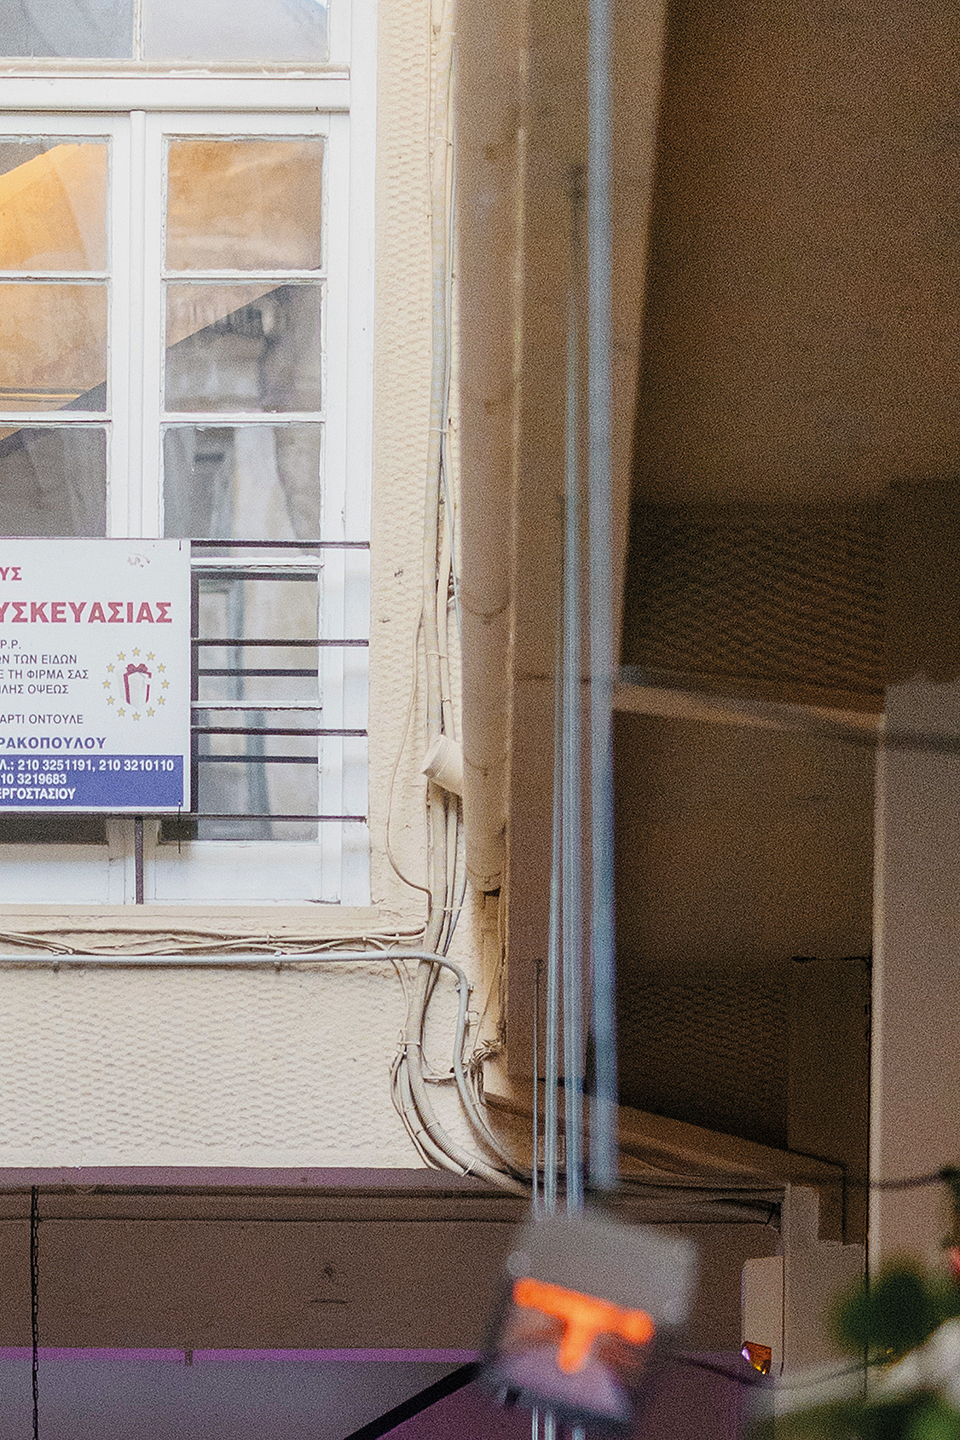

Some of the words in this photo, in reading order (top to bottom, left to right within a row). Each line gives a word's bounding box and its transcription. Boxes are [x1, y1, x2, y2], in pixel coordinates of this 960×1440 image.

[13, 653, 38, 665] ΤΩΝ
[41, 653, 78, 665] ΕΙΔΩΝ
[7, 668, 23, 680] ΤΗ
[26, 669, 65, 680] ΦΙΡΜΑ
[67, 669, 89, 680] ΣΑΣ
[27, 683, 69, 695] ΟΨΕΩΣ
[28, 713, 84, 725] ΟΝΤΟΥΛΕ
[17, 758, 40, 771] 210
[42, 758, 96, 773] 3251191,
[98, 759, 121, 771] 210
[123, 759, 175, 772] 3210110
[16, 773, 67, 785] 3219683
